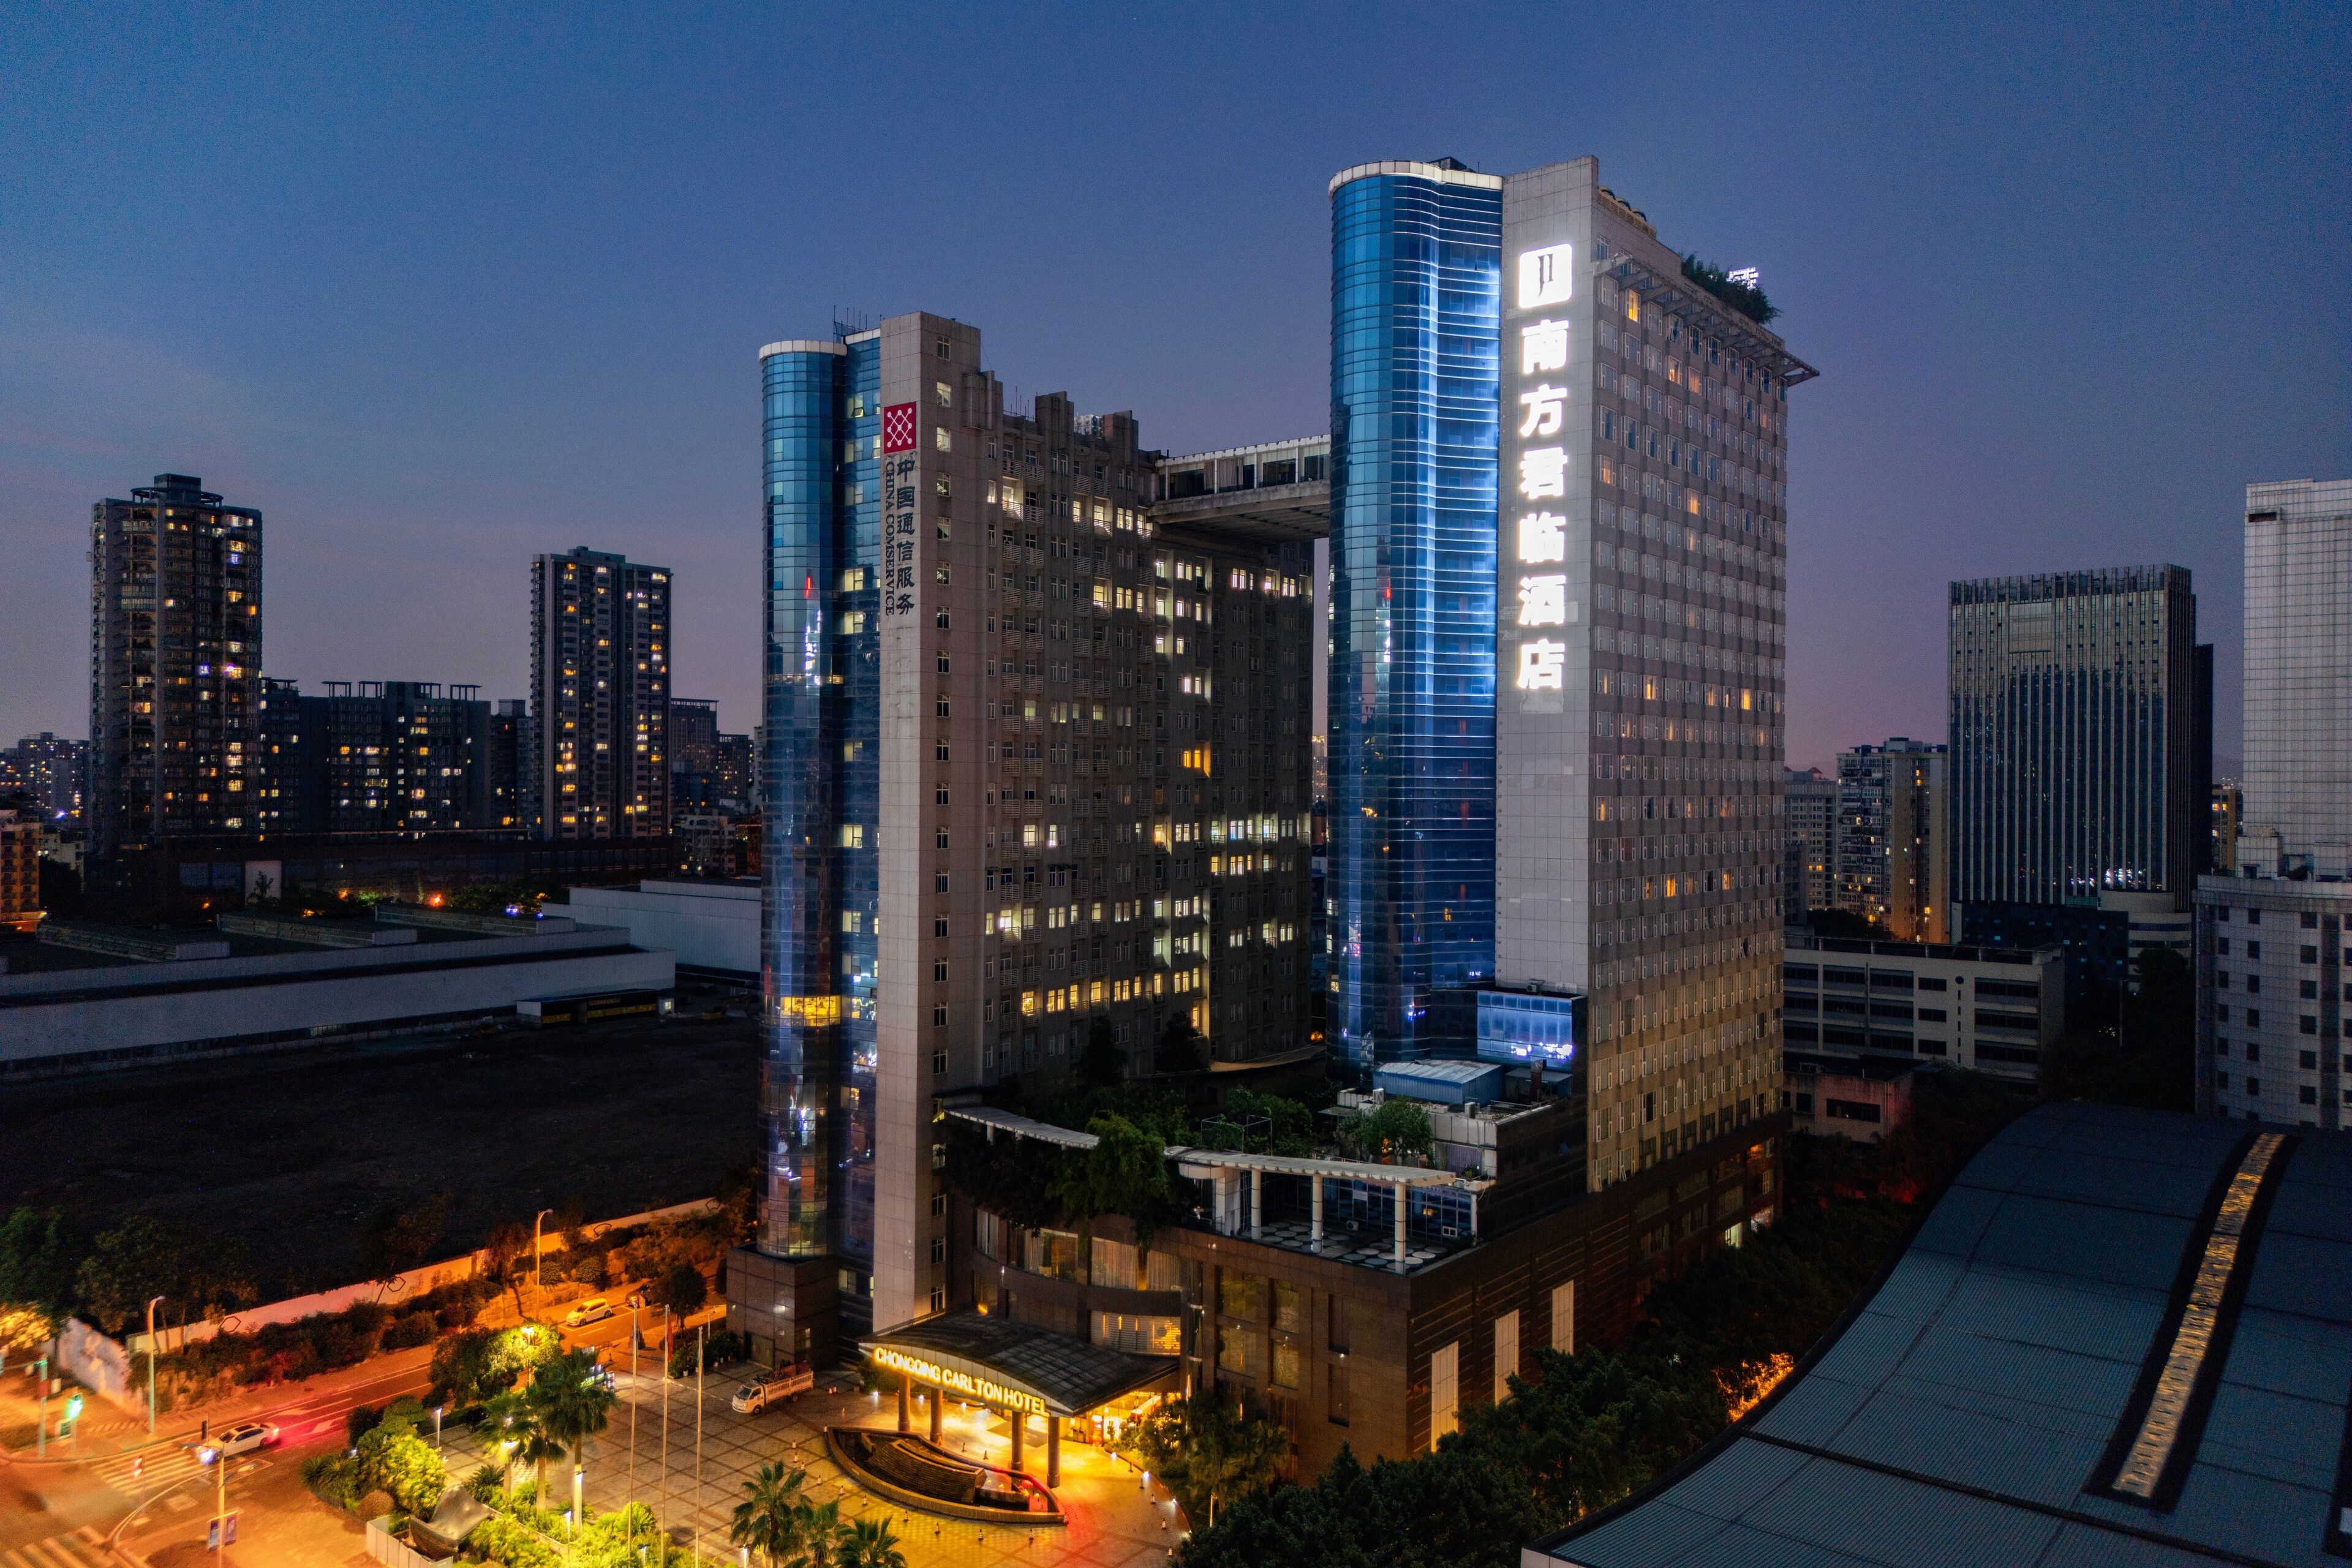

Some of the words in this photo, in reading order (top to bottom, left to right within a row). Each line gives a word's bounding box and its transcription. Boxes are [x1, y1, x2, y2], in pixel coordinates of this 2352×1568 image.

[886, 461, 895, 511] CHINA
[896, 459, 916, 615] 中国通信服务
[1517, 318, 1569, 689] 南方君临酒店
[886, 513, 895, 616] COMSERVICE
[942, 1368, 1003, 1402] CARLTON
[1003, 1387, 1050, 1417] HOTEL
